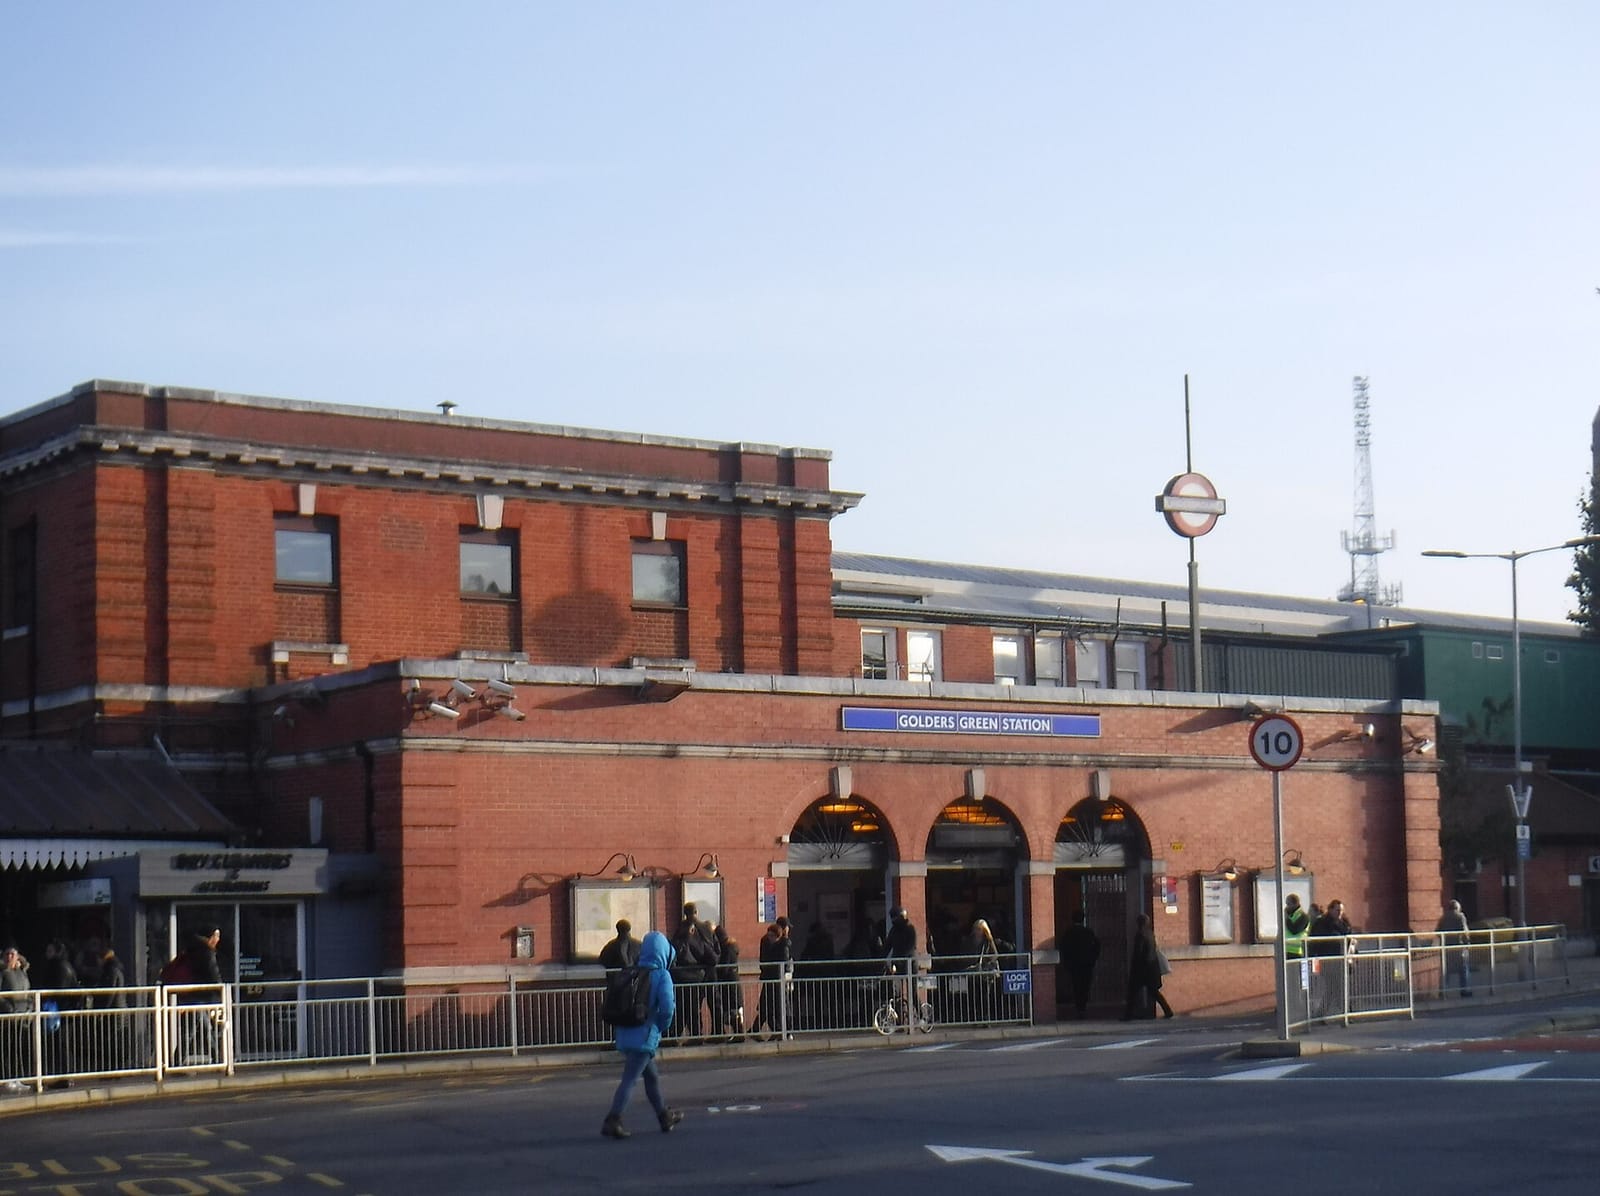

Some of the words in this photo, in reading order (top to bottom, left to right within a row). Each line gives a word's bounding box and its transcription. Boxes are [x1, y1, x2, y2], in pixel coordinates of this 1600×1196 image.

[899, 714, 955, 729] GOLDERS
[959, 716, 998, 730] GREEN
[1002, 717, 1050, 731] STATION
[1261, 731, 1292, 755] 10
[1006, 974, 1027, 982] LOOK
[1009, 982, 1026, 991] LEFT
